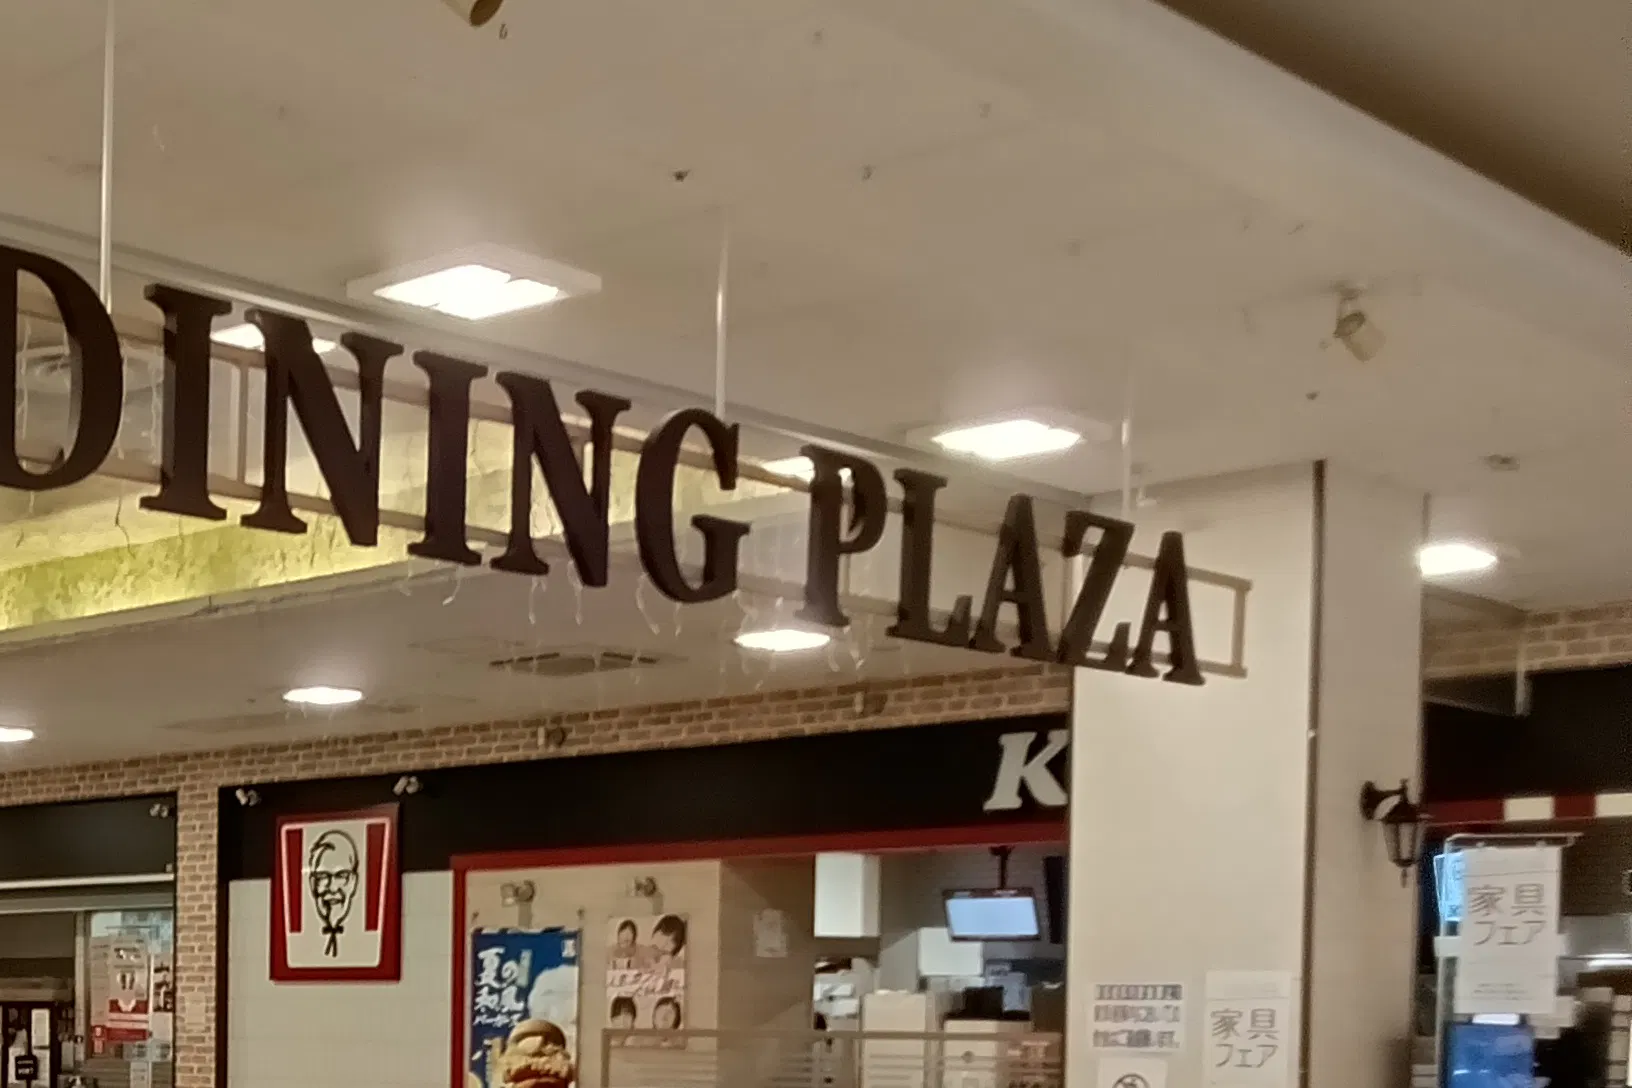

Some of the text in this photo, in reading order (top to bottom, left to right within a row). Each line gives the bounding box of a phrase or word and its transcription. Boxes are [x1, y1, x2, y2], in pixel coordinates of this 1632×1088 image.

[799, 443, 1206, 686] PLAZA
[1468, 884, 1547, 917] 家具
[1474, 920, 1547, 946] フェア
[1210, 1008, 1280, 1040] 家具
[1215, 1043, 1279, 1068] フェア
